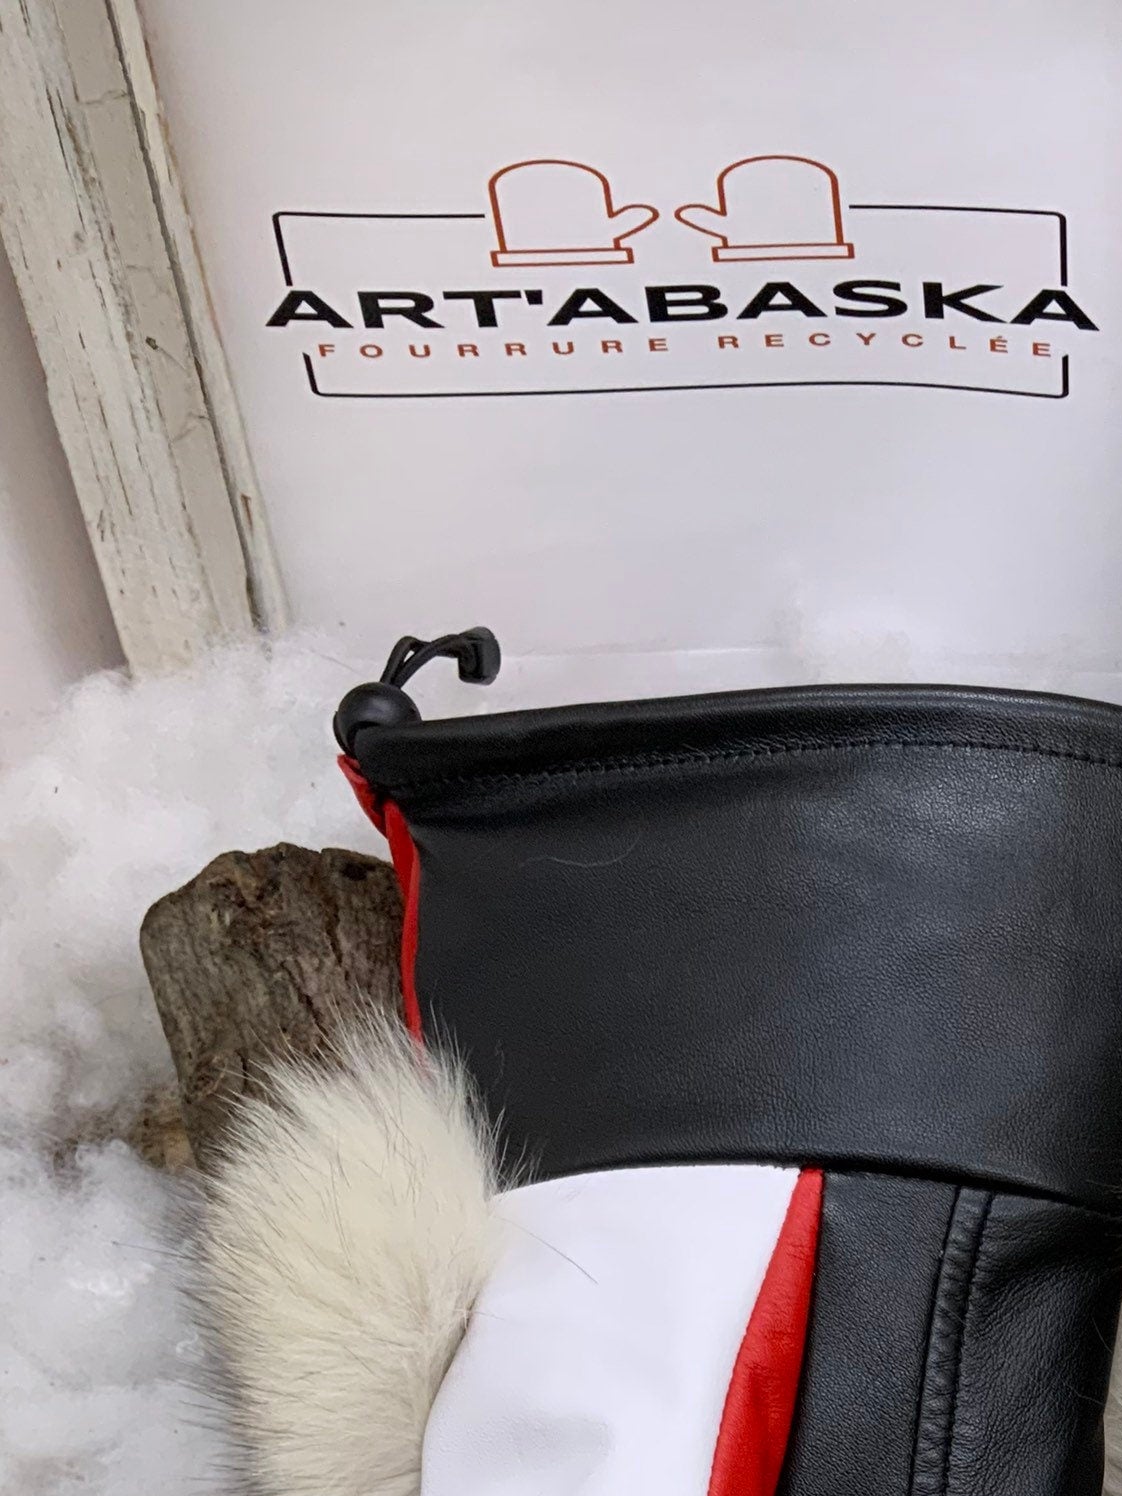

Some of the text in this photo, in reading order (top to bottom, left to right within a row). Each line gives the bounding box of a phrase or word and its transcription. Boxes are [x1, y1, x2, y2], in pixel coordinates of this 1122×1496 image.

[265, 281, 1099, 331] ART'ABASKA
[318, 332, 1054, 358] FOURRURE RECYCLÉE
